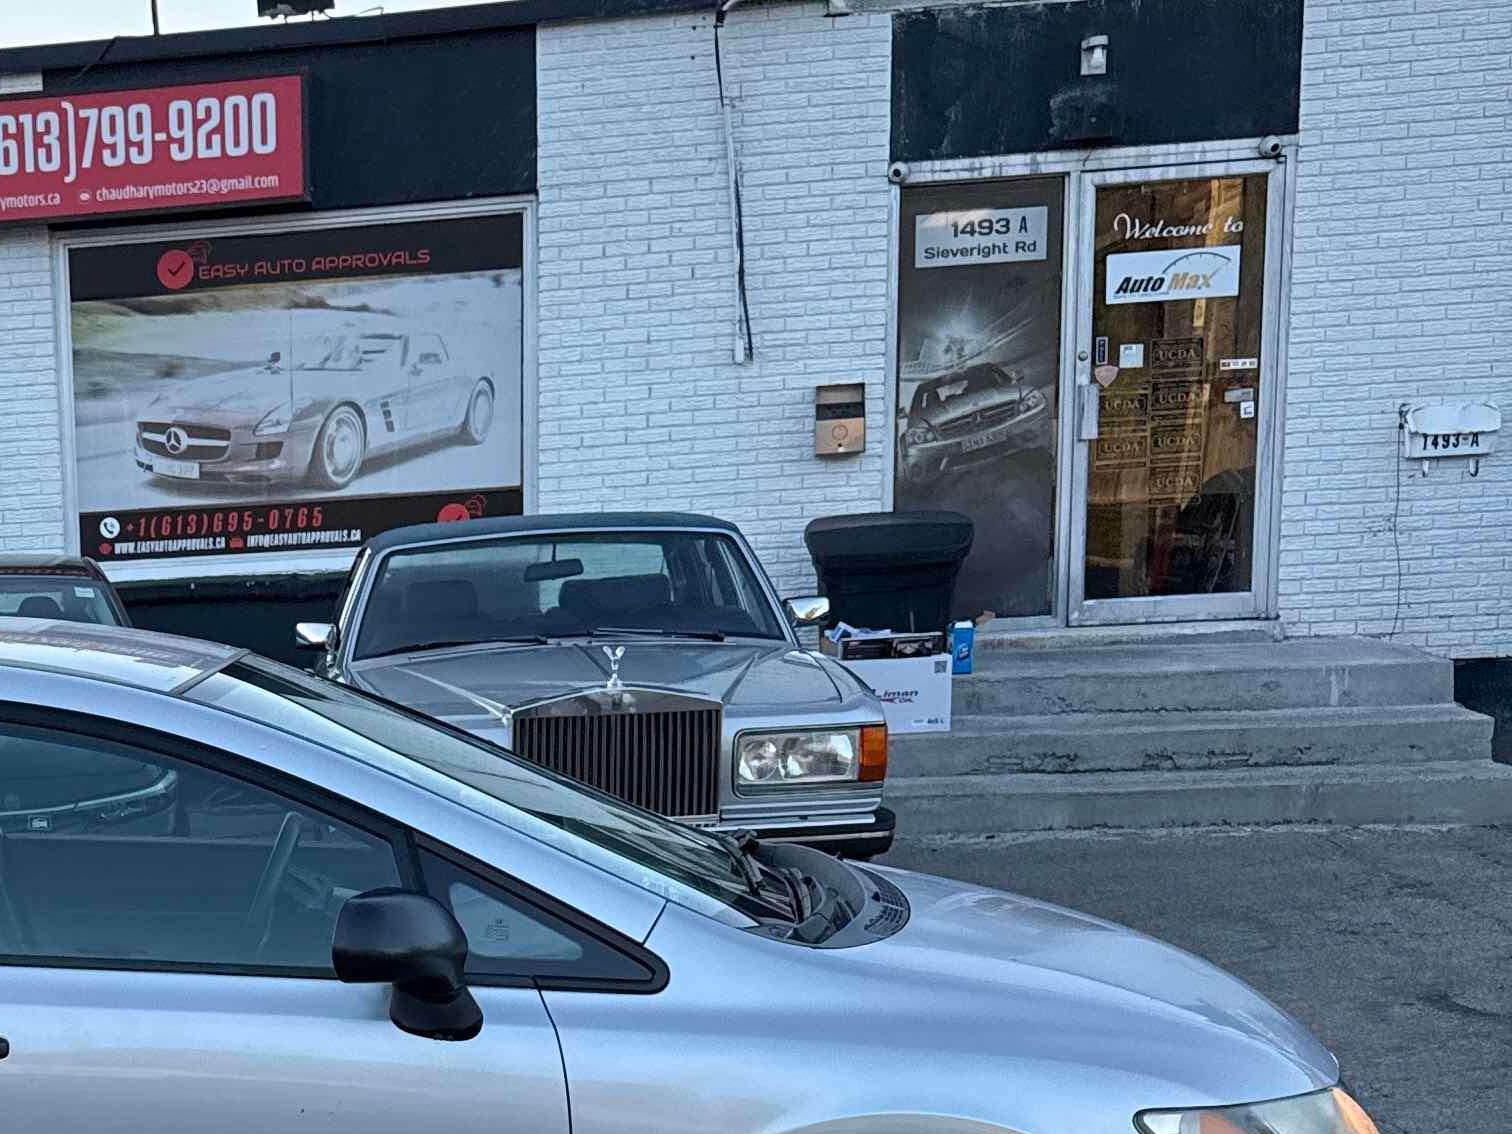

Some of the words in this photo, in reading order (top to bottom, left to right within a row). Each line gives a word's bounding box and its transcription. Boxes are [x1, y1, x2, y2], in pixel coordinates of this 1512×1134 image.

[96, 175, 279, 202] chaudharymotors23@gmail.com
[951, 218, 1011, 238] 1493
[1019, 216, 1028, 233] A
[1113, 213, 1213, 240] Welcome
[1223, 215, 1244, 233] to
[924, 243, 1008, 260] Sieveright
[1015, 240, 1037, 253] Rd
[198, 263, 249, 280] EASY
[254, 259, 306, 275] AUTO
[311, 249, 430, 271] APPROVALS
[1422, 432, 1480, 451] 1493-A
